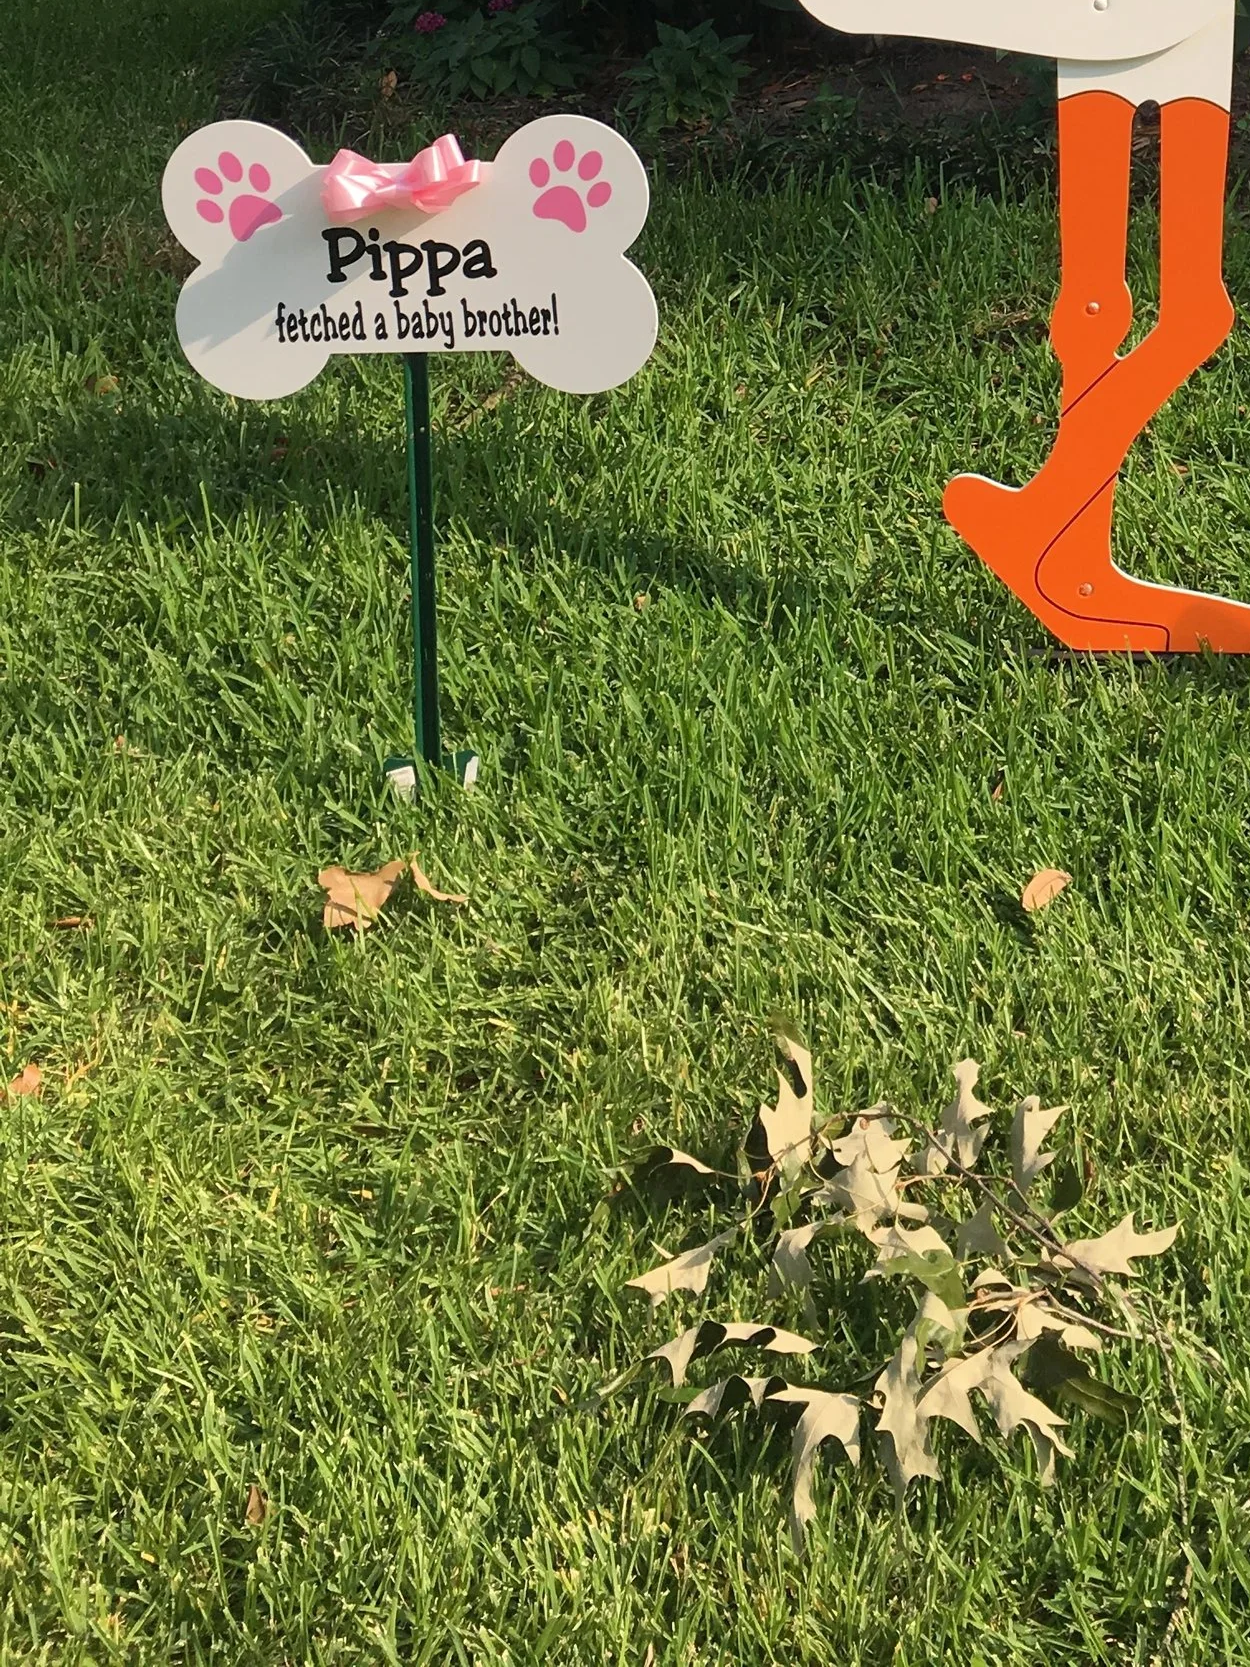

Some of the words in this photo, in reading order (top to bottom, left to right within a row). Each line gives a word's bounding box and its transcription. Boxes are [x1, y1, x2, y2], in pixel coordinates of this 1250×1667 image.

[321, 226, 498, 298] Pippa
[274, 300, 367, 343] fetched
[374, 312, 389, 341] a
[394, 299, 455, 349] baby
[460, 292, 559, 338] brother!
